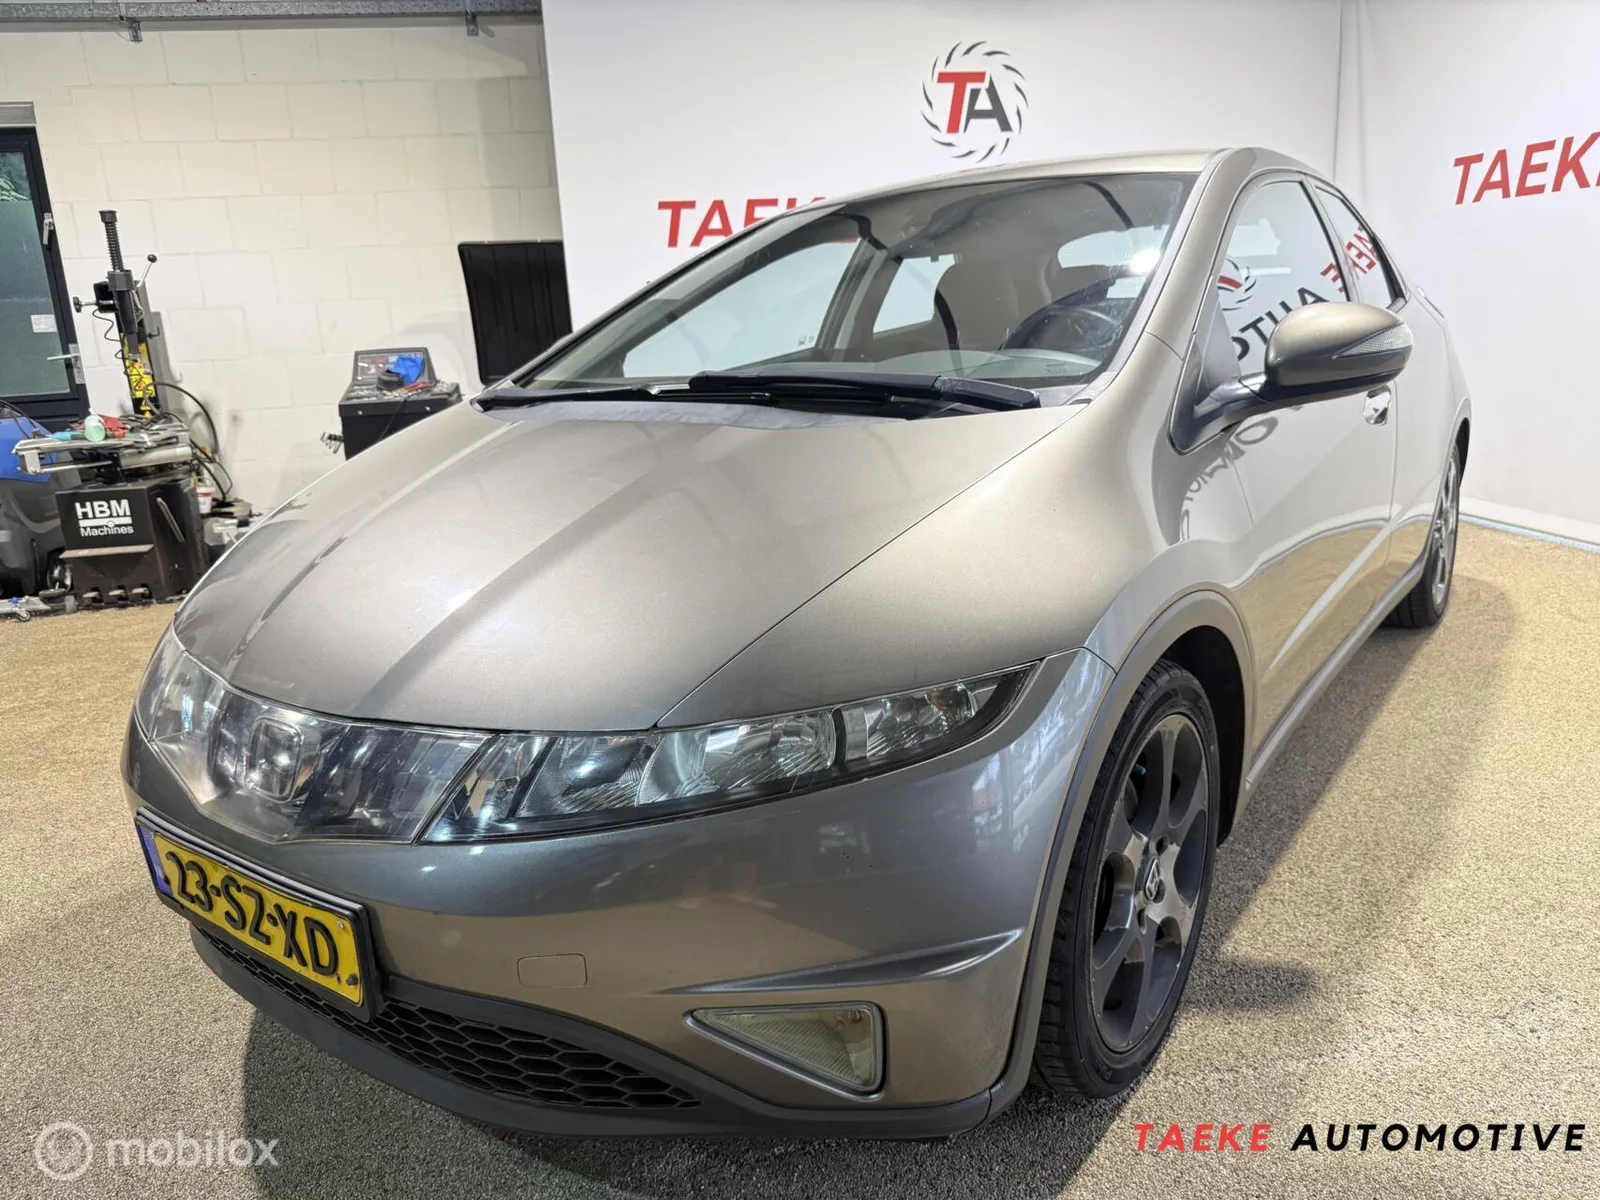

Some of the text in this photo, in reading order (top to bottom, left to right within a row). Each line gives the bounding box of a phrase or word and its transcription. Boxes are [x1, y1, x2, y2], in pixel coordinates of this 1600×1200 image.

[936, 71, 1013, 134] TA
[1453, 131, 1600, 205] TAEK
[658, 197, 826, 248] TAE
[75, 499, 131, 519] HBM
[80, 526, 134, 537] Machines
[165, 851, 339, 976] 23-SZ-XD
